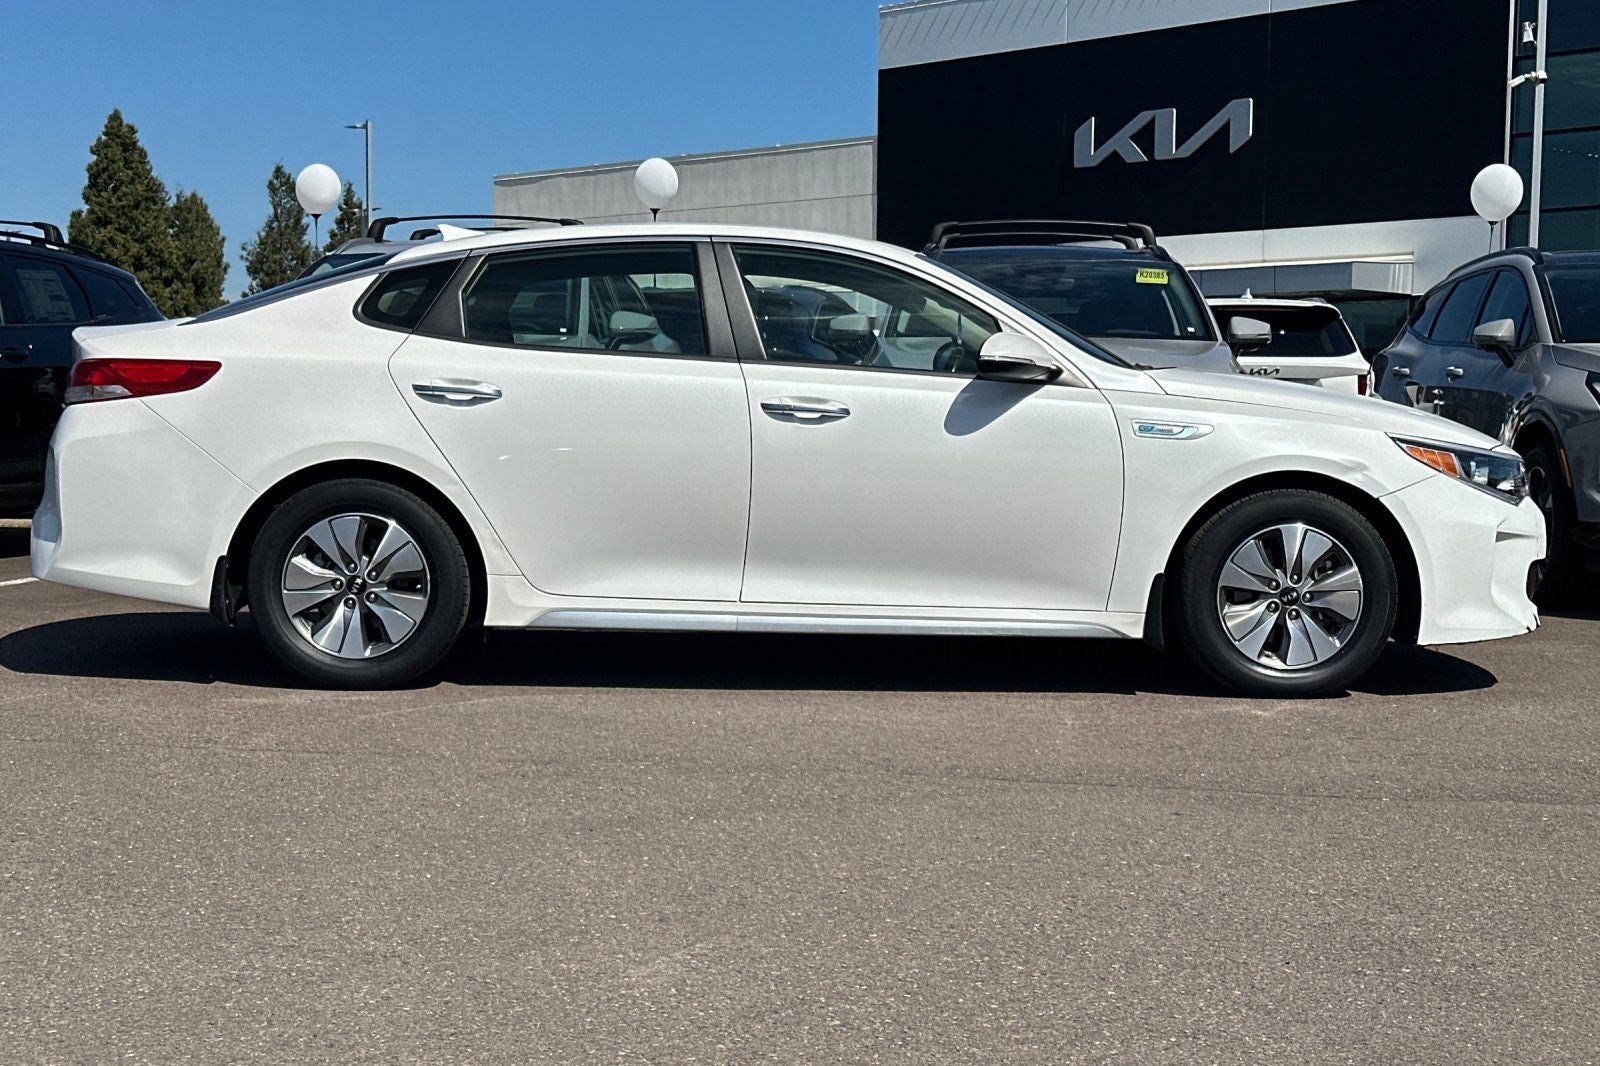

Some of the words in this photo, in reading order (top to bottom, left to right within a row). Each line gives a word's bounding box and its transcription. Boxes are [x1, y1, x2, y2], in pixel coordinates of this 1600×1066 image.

[1073, 97, 1254, 168] KIA
[1139, 270, 1166, 280] K20385
[349, 577, 364, 594] KIA
[1281, 591, 1298, 603] KIA
